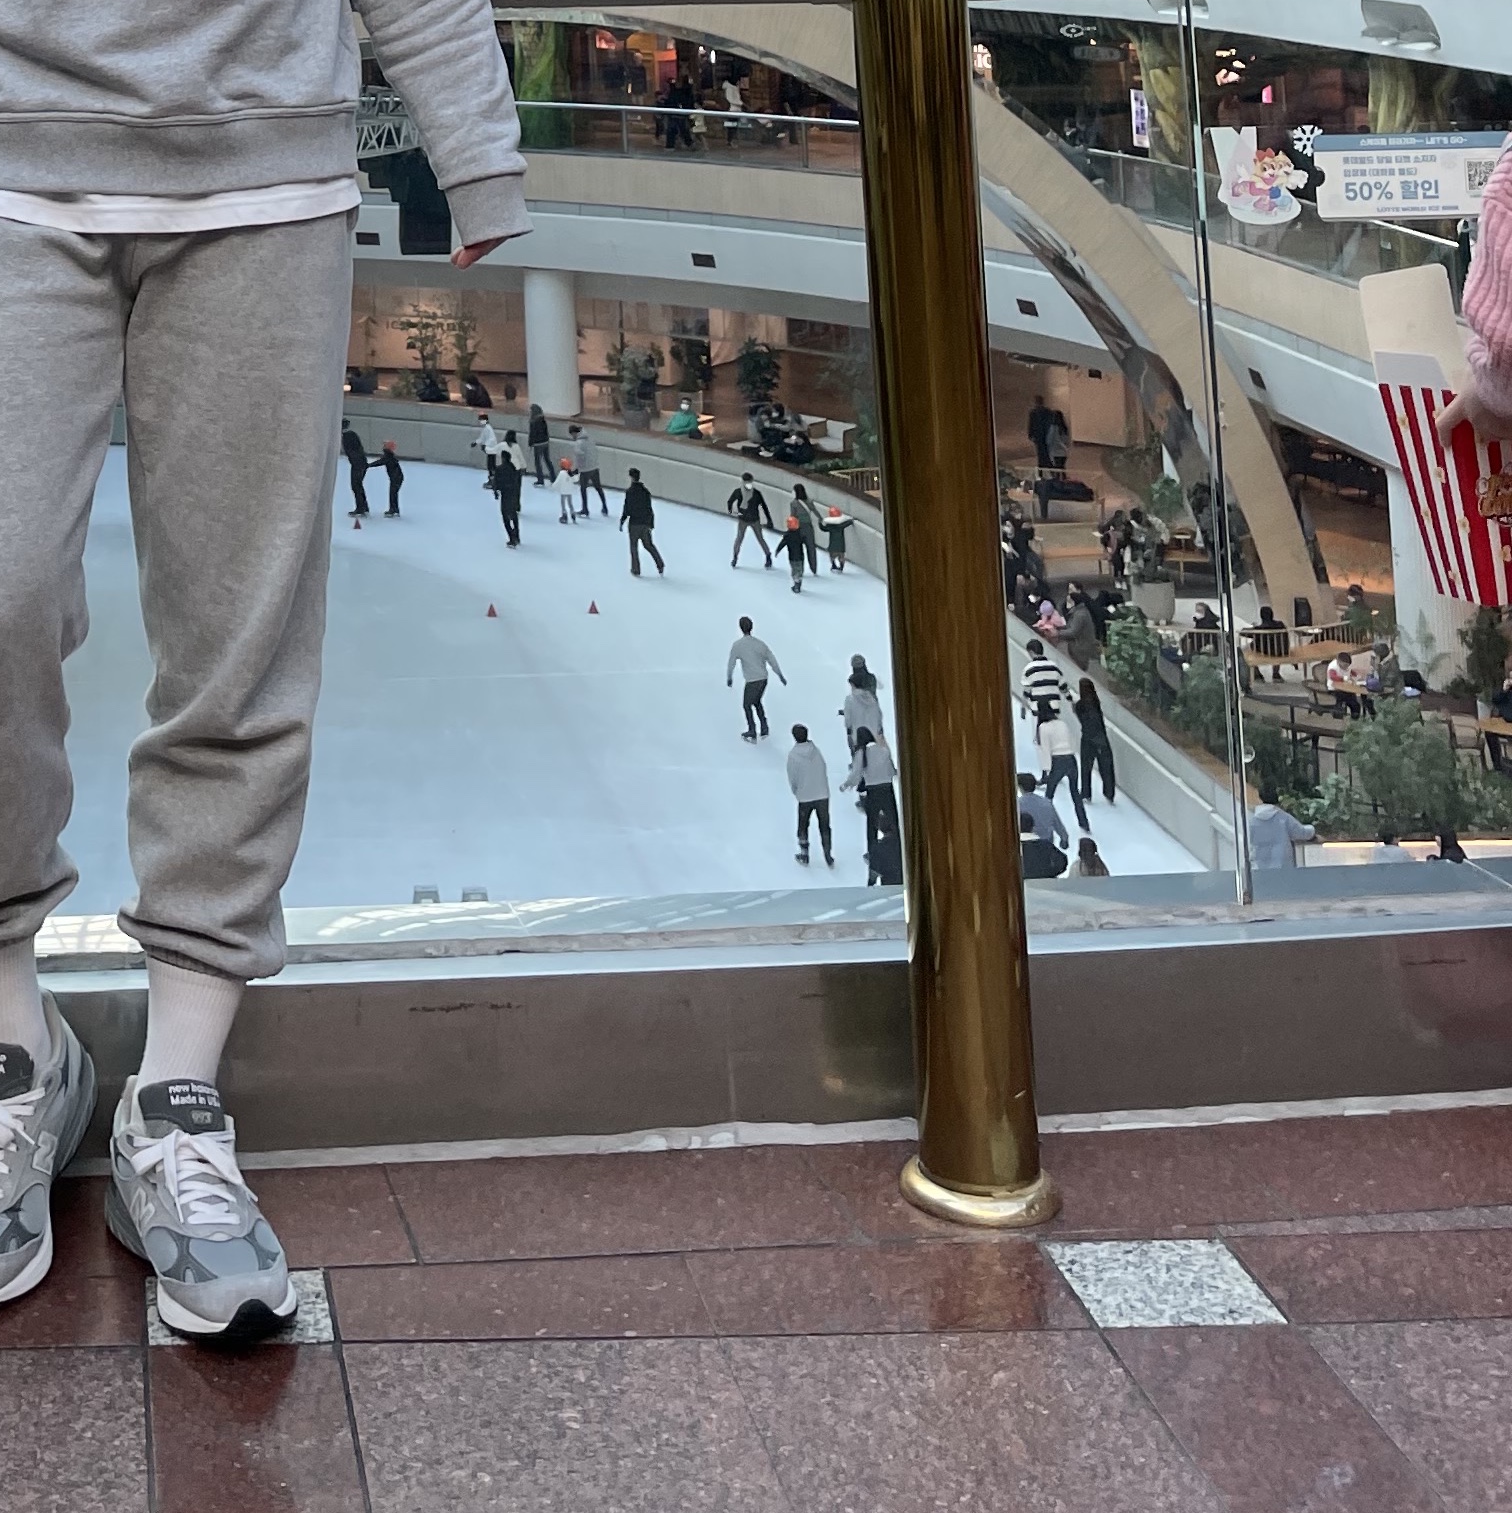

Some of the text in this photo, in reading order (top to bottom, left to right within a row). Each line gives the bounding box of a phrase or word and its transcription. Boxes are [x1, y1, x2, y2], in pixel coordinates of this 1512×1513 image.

[1345, 179, 1440, 201] 50% 할인
[168, 1085, 190, 1094] new
[170, 1094, 197, 1106] Made
